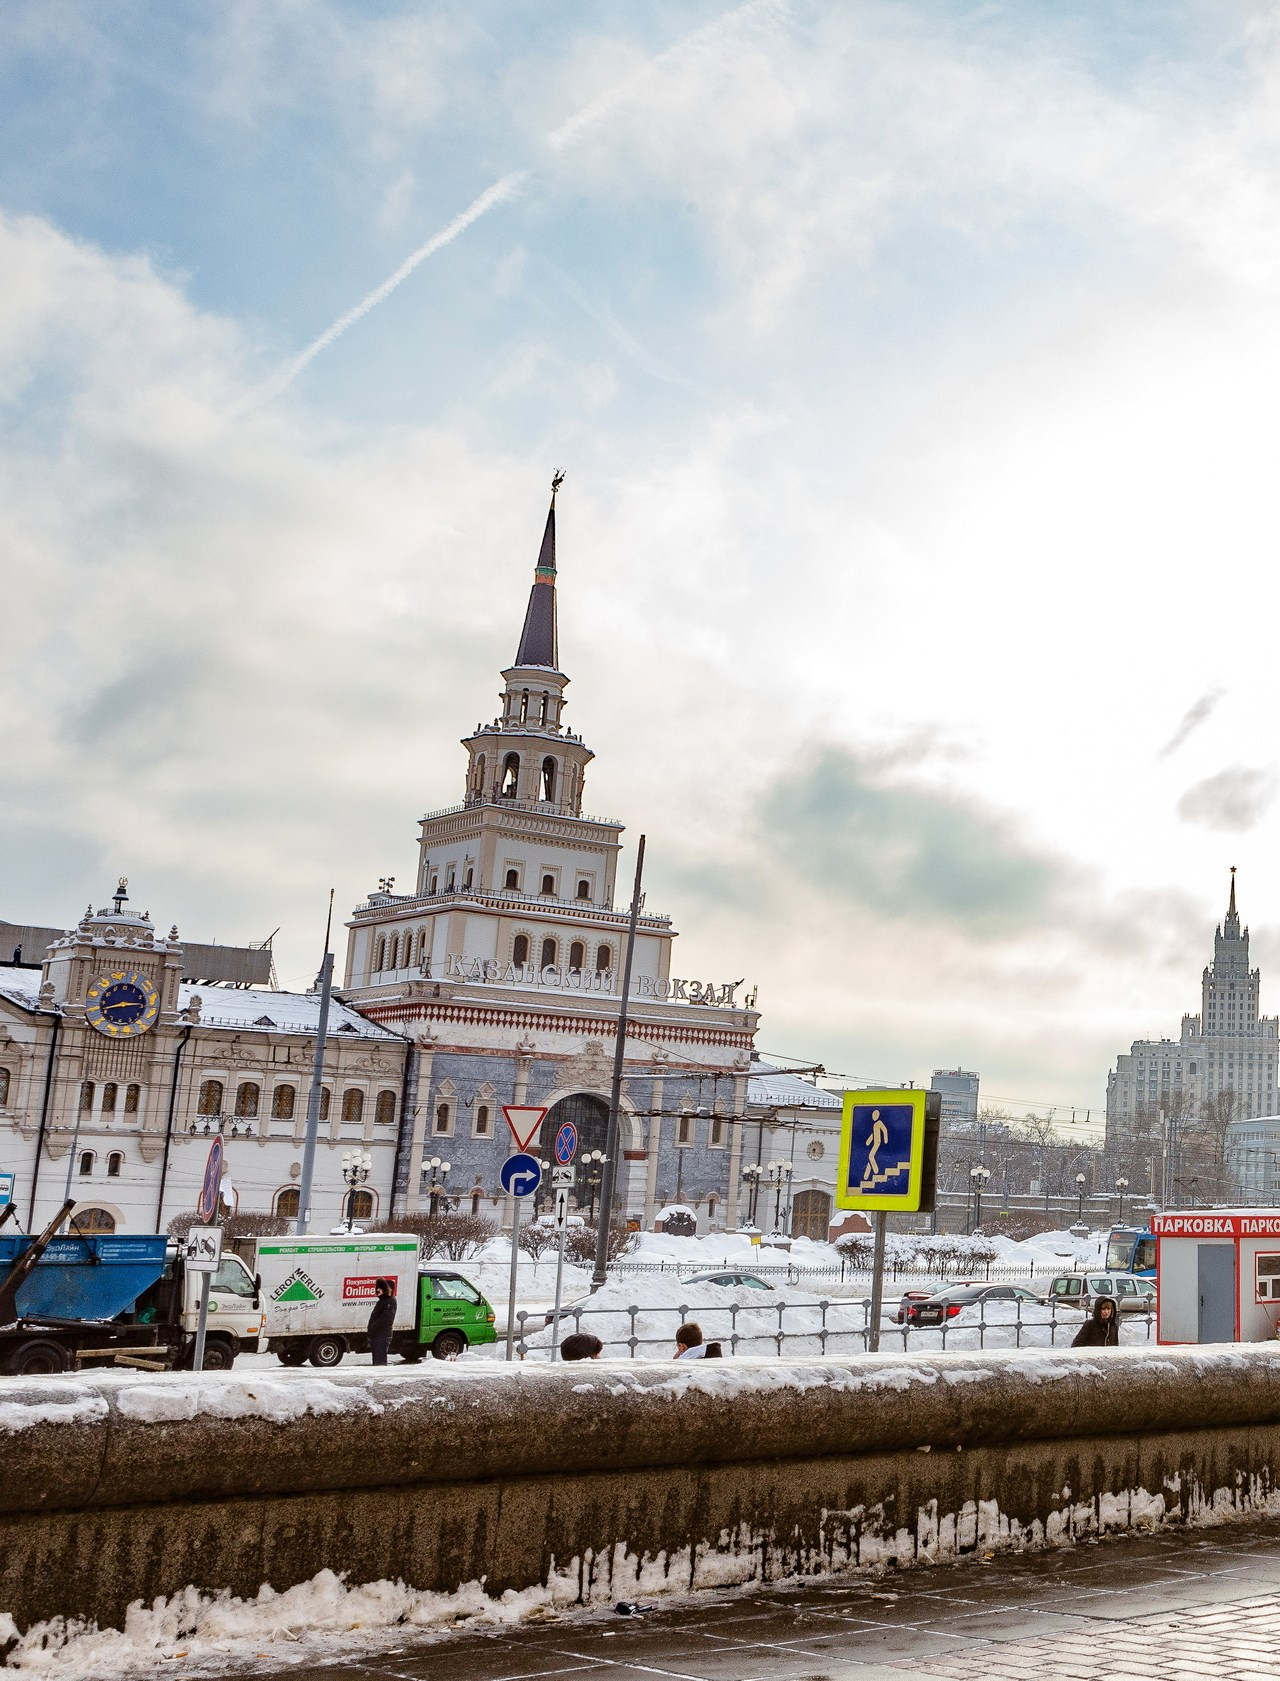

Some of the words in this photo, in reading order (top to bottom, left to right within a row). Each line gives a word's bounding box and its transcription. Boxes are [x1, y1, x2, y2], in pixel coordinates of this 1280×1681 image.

[448, 953, 617, 993] КАЗАНСКИЙ
[637, 975, 735, 1005] ВОКЗАЛ
[1153, 1217, 1234, 1233] ПАРКОВКА
[269, 1273, 297, 1301] LEROY
[294, 1267, 325, 1299] MERLIN
[346, 1286, 376, 1296] Online
